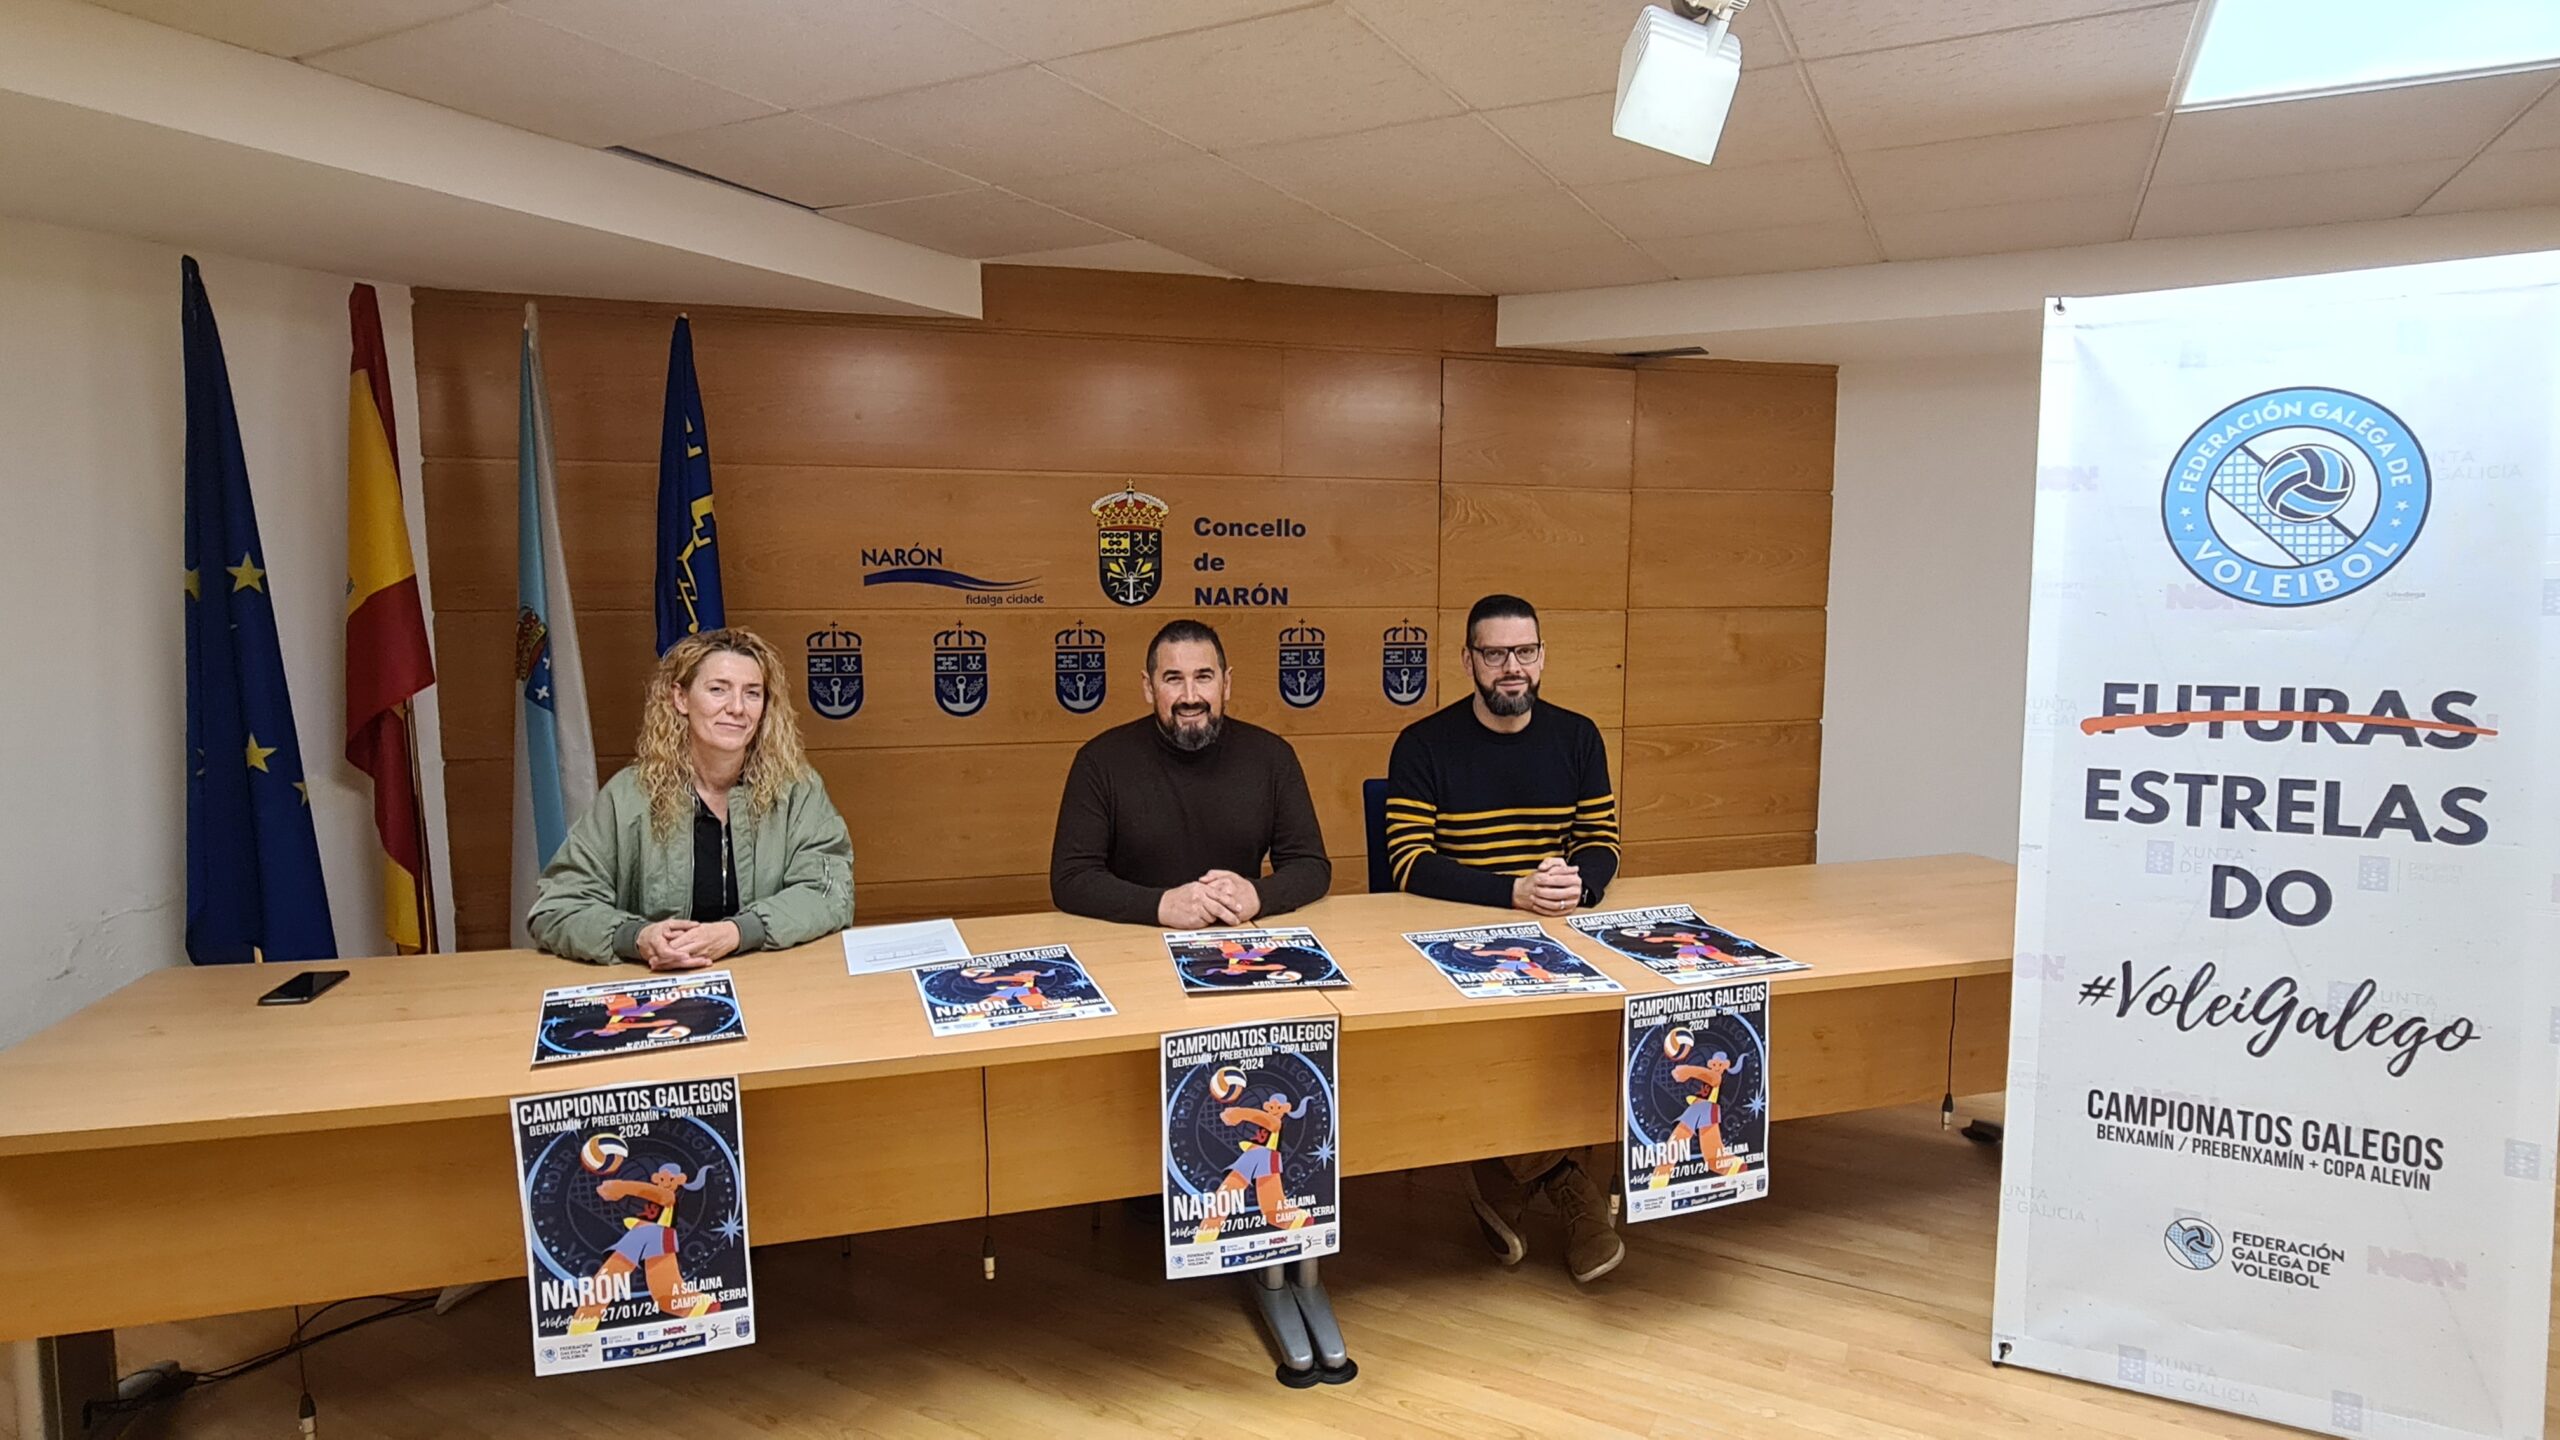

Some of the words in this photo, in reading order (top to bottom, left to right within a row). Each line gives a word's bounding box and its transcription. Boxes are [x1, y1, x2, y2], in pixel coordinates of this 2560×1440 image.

[2179, 399, 2303, 494] FEDERACIÓN
[2308, 401, 2396, 458] GALEGA
[2386, 457, 2413, 487] DE
[1193, 517, 1307, 538] Concello
[861, 542, 943, 567] NARÓN
[1193, 552, 1226, 572] de
[2192, 539, 2399, 599] VOLEIBOL
[965, 593, 1003, 607] fidalga
[1006, 592, 1045, 605] cidade
[1193, 581, 1289, 607] NARÓN
[2101, 682, 2478, 750] FUTURAS
[2084, 767, 2489, 846] ESTRELAS
[2209, 864, 2333, 928] DO
[1630, 991, 1712, 1019] CAMPIONATOS
[1715, 984, 1766, 1007] GALEGOS
[1689, 1019, 1709, 1032] 2024
[2078, 960, 2482, 1078] #VoleiGalego
[1167, 1025, 1266, 1058] CAMPIONATOS
[1269, 1023, 1333, 1044] GALEGOS
[1240, 1058, 1264, 1071] 2024
[519, 1090, 651, 1125] CAMPIONATOS
[655, 1081, 734, 1108] GALEGOS
[529, 1118, 582, 1137] BENXAMÍN
[591, 1109, 660, 1127] PREBENXAMÍN
[669, 1107, 694, 1119] COPA
[696, 1101, 728, 1117] ALEVÍN
[618, 1123, 649, 1139] 2024
[2087, 1088, 2293, 1148] CAMPIONATOS
[2302, 1119, 2445, 1171] GALEGOS
[1631, 1134, 1692, 1171] NARÓN
[2096, 1123, 2175, 1151] BENXAMÍN
[2191, 1138, 2305, 1171] PREBENXAMÍN
[2323, 1158, 2367, 1181] COPA
[2370, 1165, 2431, 1191] ALEVÍN
[1670, 1161, 1709, 1179] 27/01/24
[1173, 1184, 1246, 1222] NARÓN
[1220, 1215, 1268, 1233] 27/01/24
[2231, 1246, 2303, 1271] GALEGA
[2307, 1260, 2331, 1276] DE
[2232, 1231, 2345, 1263] FEDERACIÓN
[672, 1283, 680, 1296] A
[681, 1276, 723, 1294] SOLAINA
[2231, 1260, 2320, 1289] VOLEIBOL
[541, 1271, 632, 1311] NARÓN
[718, 1287, 748, 1303] SERRA
[600, 1301, 660, 1322] 27/01/24
